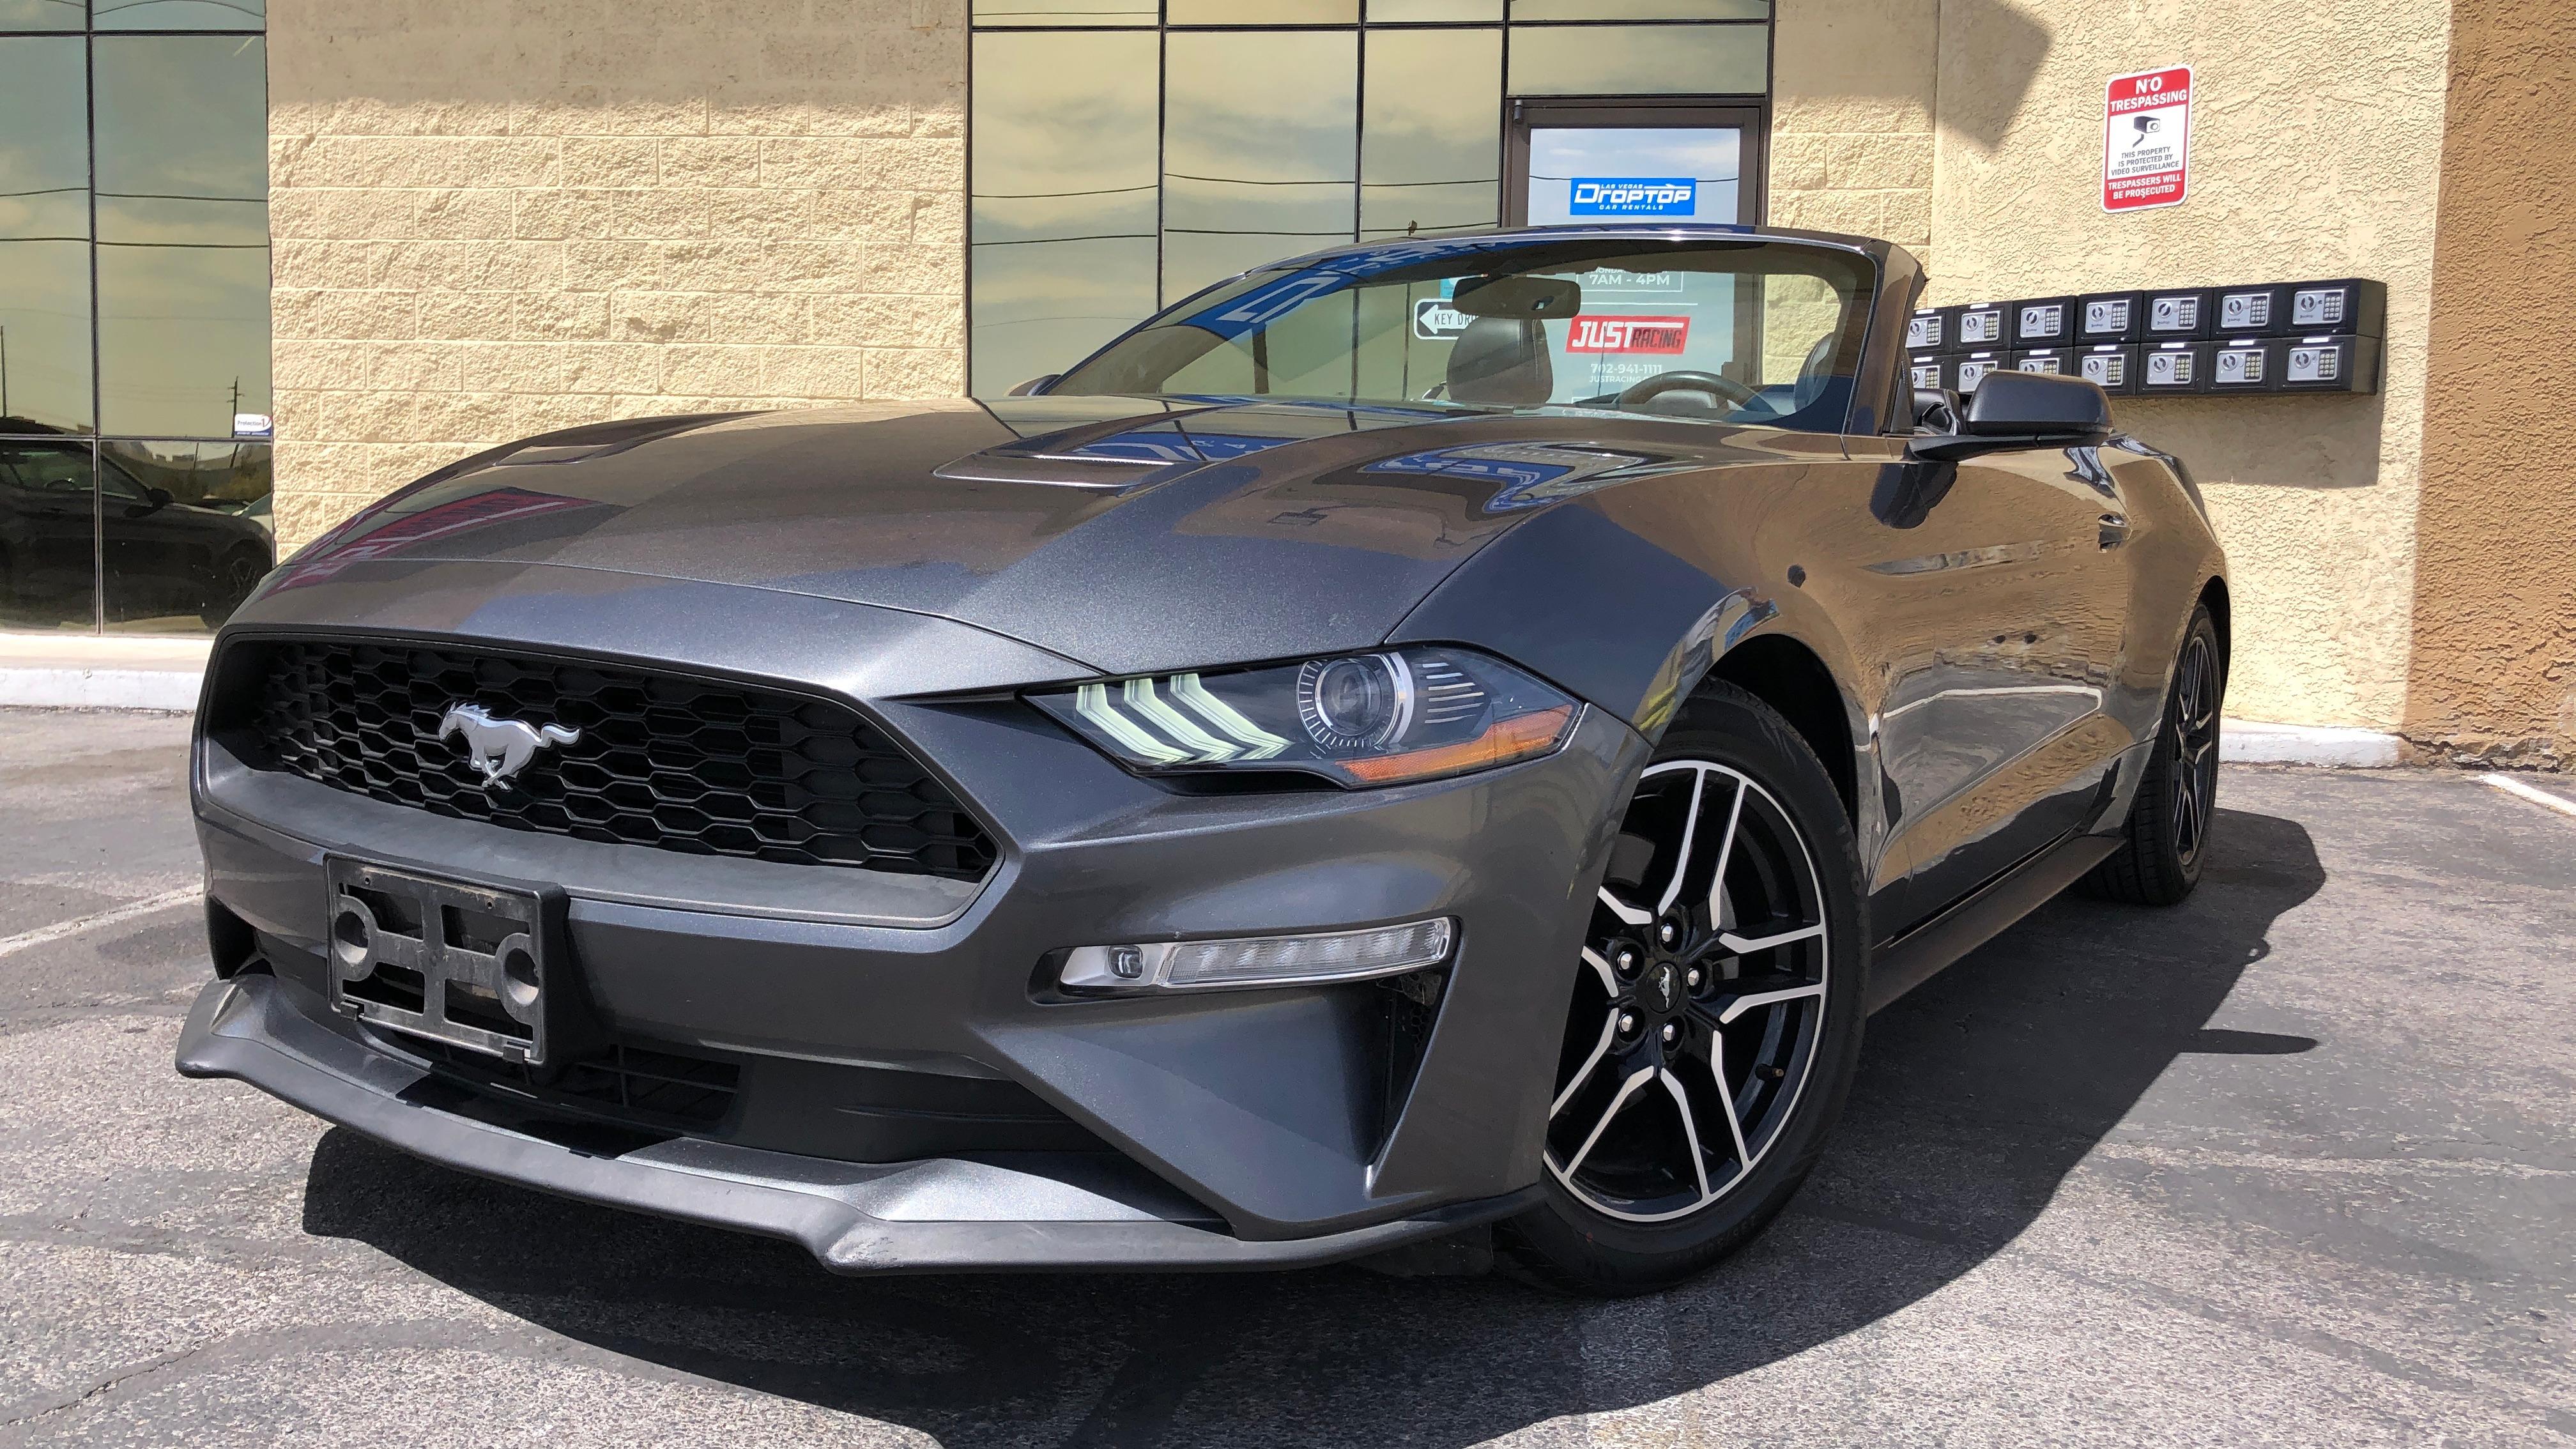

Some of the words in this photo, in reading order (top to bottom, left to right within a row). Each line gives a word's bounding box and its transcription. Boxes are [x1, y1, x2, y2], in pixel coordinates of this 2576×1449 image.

[2136, 77, 2162, 95] NO
[2110, 89, 2187, 112] TRESPASSING
[2137, 146, 2170, 157] PROPERTY
[2111, 167, 2130, 176] VIDEO
[2132, 160, 2179, 173] SURVEILLANCE
[2126, 155, 2163, 166] PROTECTED
[2108, 176, 2161, 190] TRESPASSERS
[2163, 173, 2182, 183] WILL
[2113, 190, 2124, 200] BE
[2125, 184, 2175, 199] PROSECUTED
[1590, 274, 1622, 285] 7AM
[1636, 274, 1670, 286] 4PM
[1434, 313, 1453, 325] KEY
[1572, 321, 1638, 348] JUST
[1631, 328, 1682, 349] RACING
[1590, 363, 1662, 374] 702-941-1111
